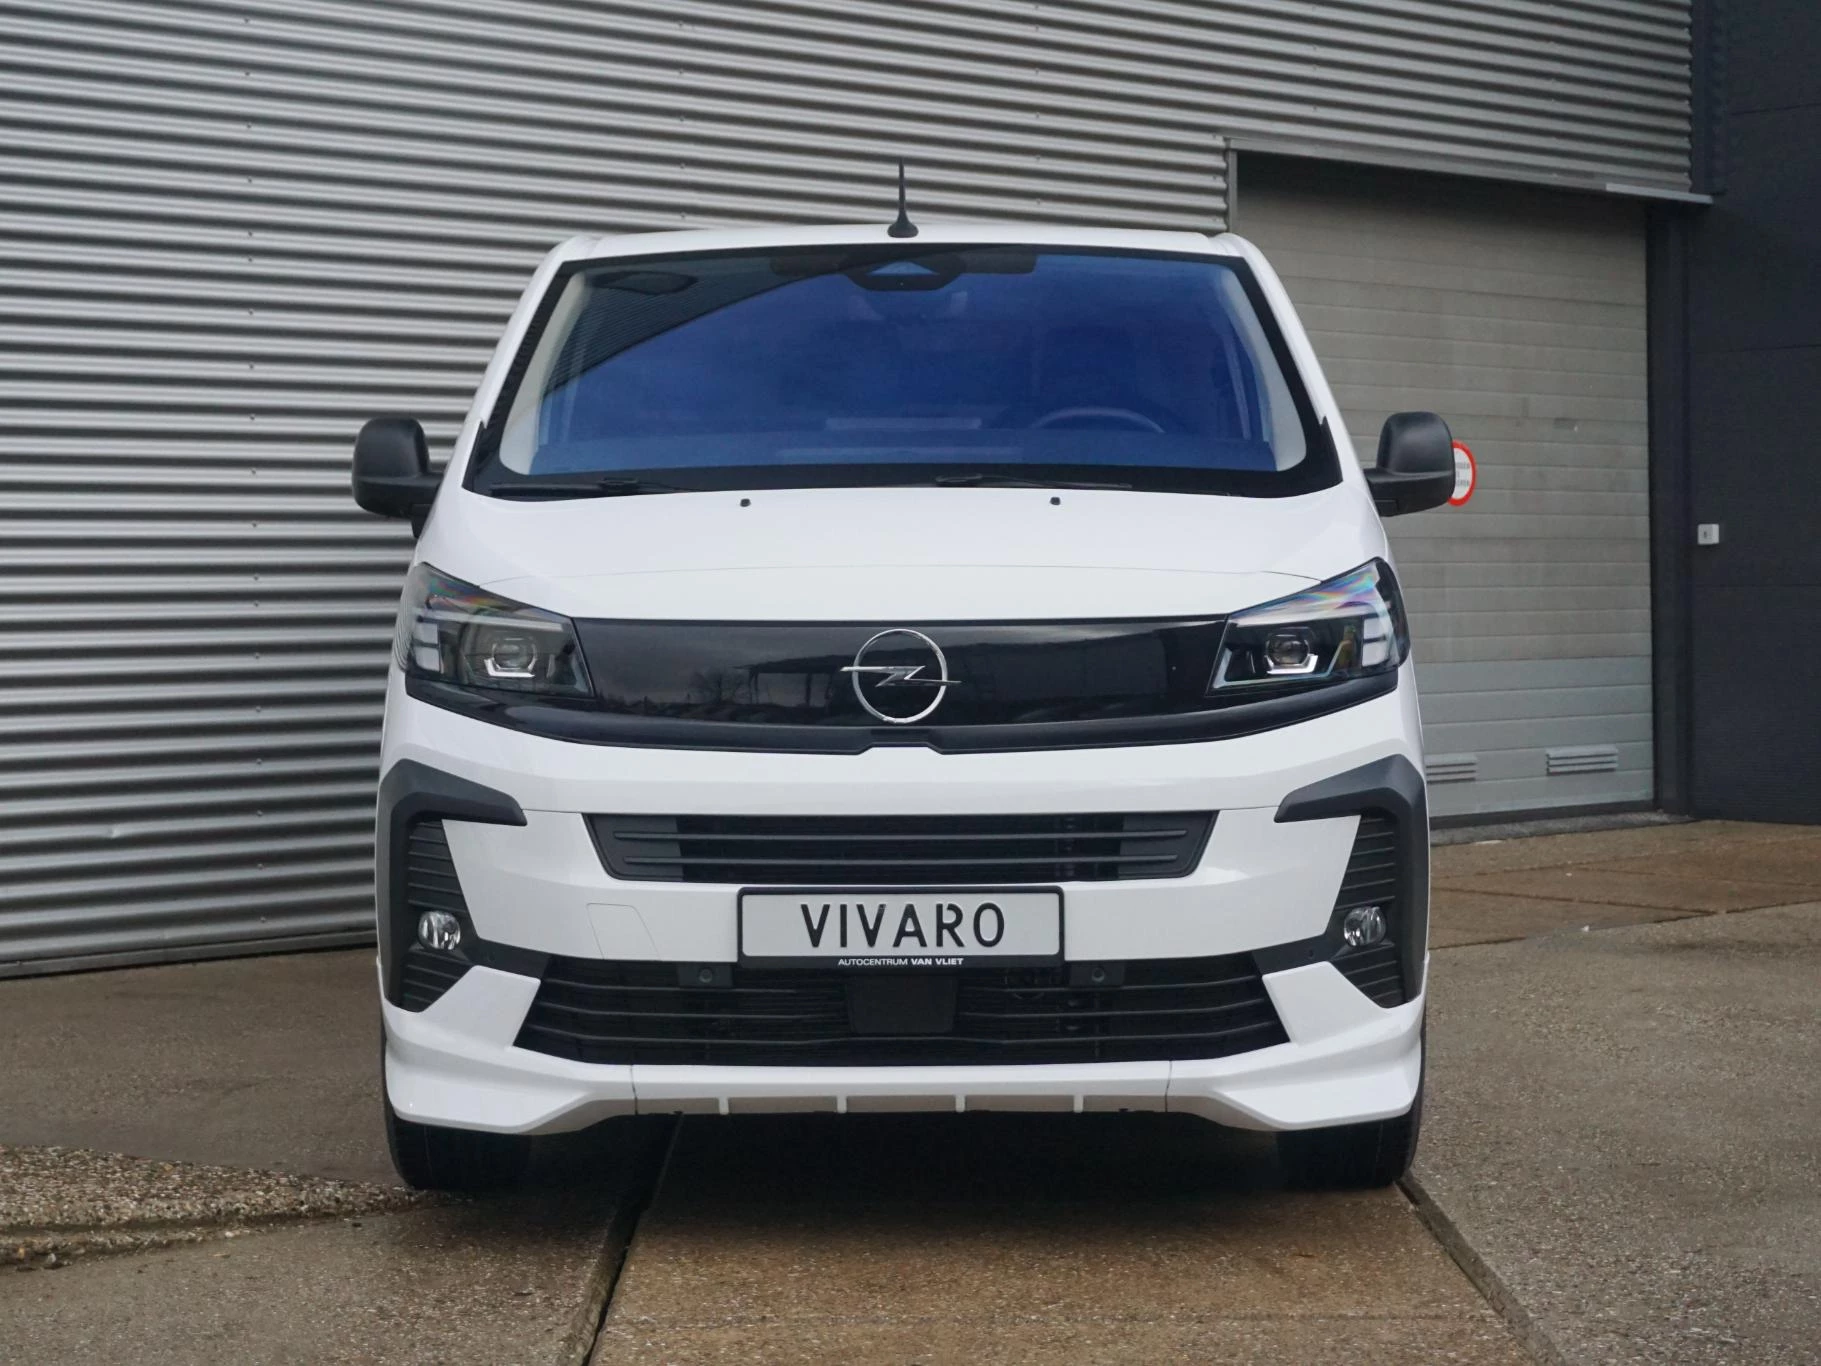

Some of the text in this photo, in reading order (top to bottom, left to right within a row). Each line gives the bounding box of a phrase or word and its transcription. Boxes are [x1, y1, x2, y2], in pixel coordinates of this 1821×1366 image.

[800, 902, 1005, 948] VIVARO
[838, 957, 964, 966] AUTOCENTRUM VAN VLIET
